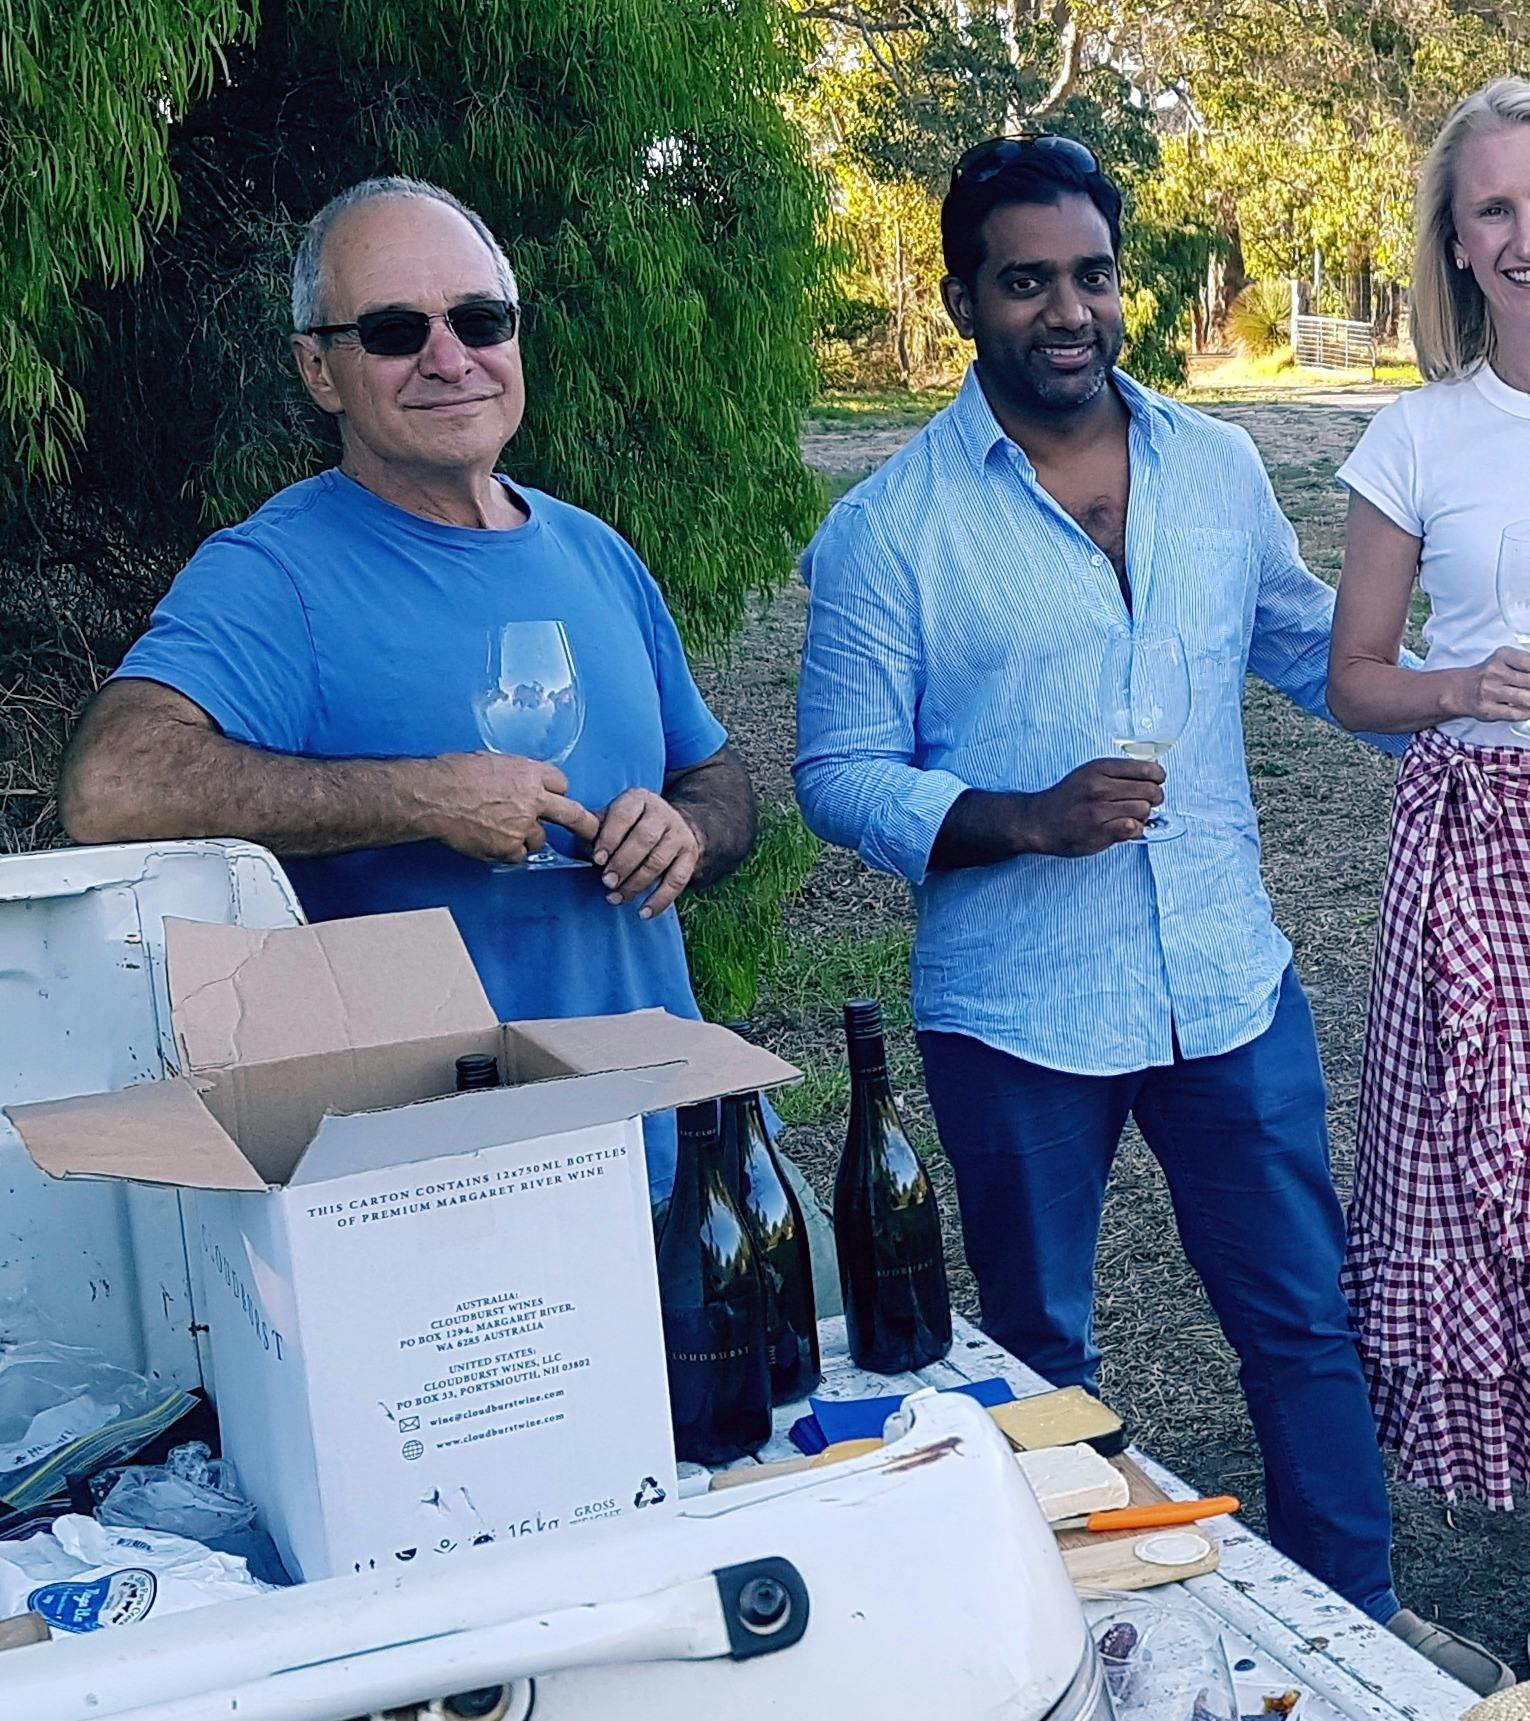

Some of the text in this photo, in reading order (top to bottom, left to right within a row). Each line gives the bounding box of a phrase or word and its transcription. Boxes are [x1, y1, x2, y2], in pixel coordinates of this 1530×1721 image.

[307, 1147, 627, 1218] THIS CARTON CONTAINS 12x750ML BOTTLES
[337, 1166, 605, 1228] OF PREMIUM MARGARET RIVER WINE
[200, 1223, 284, 1361] CLOUDBURST
[455, 1292, 520, 1313] AUSTRALIA:
[399, 1338, 416, 1349] PO
[418, 1333, 443, 1345] BOX
[476, 1310, 538, 1331] MARGARET
[430, 1297, 544, 1330] CLOUDBURST WINES
[436, 1321, 545, 1352] WA 6285 AUSTRALIA
[423, 1368, 499, 1392] CLOUDBURST
[542, 1352, 562, 1365] LLC
[448, 1356, 493, 1374] UNITED
[396, 1400, 413, 1411] PO
[415, 1393, 440, 1406] BOX
[543, 1365, 560, 1377] NH
[430, 1389, 565, 1426] wine@cloudburstwine.com
[436, 1412, 565, 1450] www.cloudburstwine.com
[574, 1498, 616, 1518] GROSS
